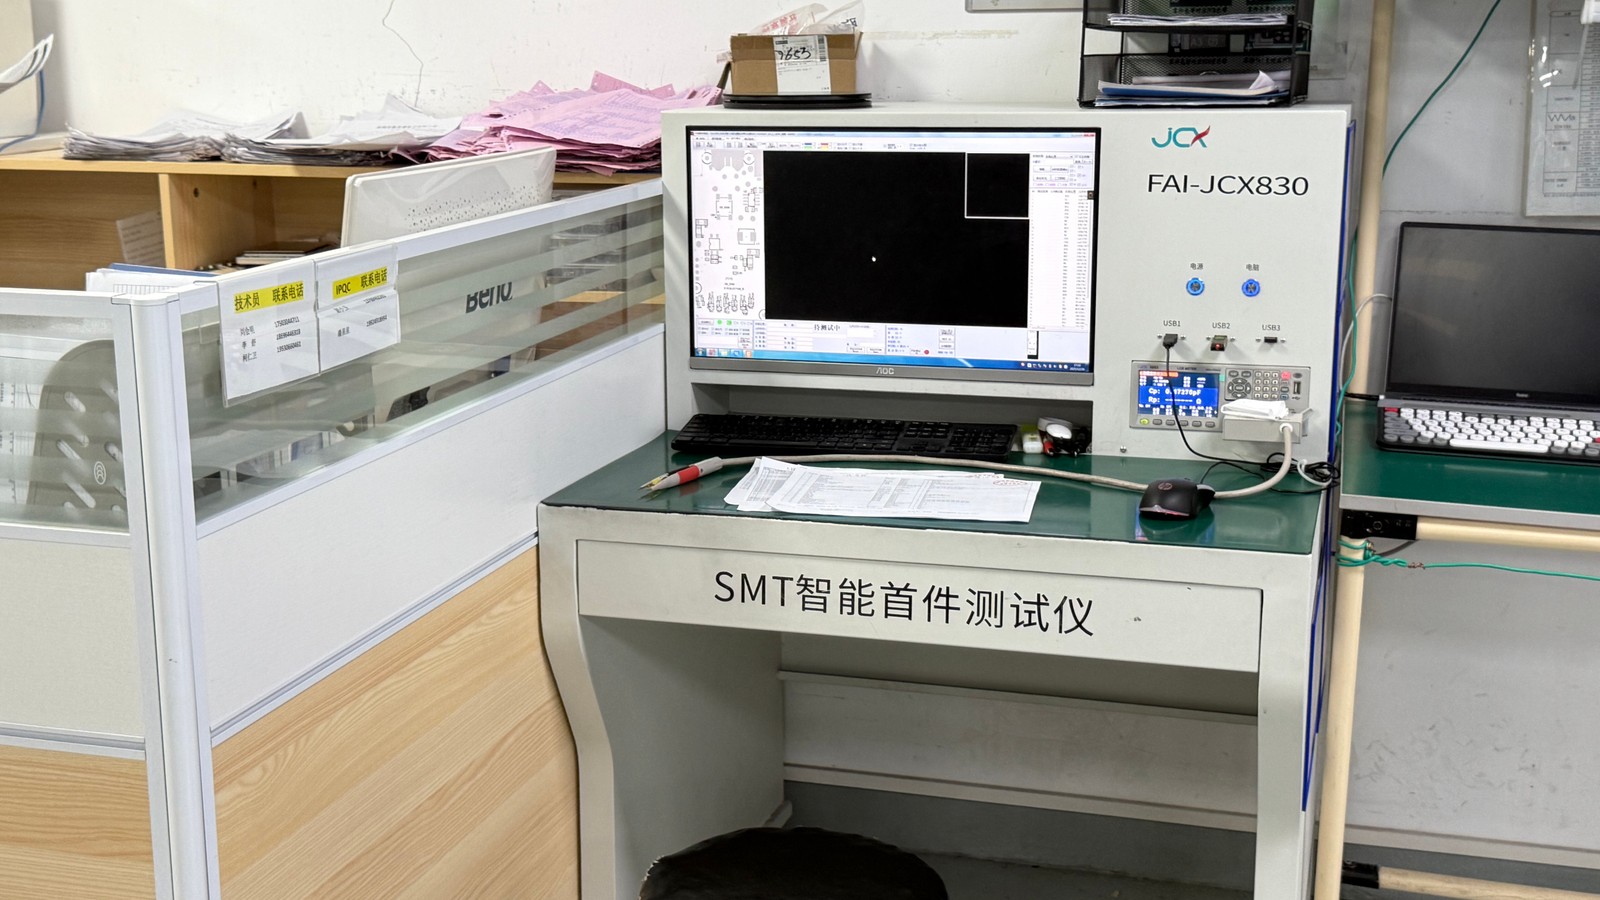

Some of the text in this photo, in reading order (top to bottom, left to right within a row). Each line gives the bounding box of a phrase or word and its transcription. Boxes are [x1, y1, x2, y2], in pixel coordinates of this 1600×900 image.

[1148, 174, 1309, 196] FAI-JCX830
[1190, 262, 1204, 271] 电源
[1246, 263, 1260, 272] 电脑
[335, 268, 388, 295] IPQC 联系电话
[234, 283, 304, 312] 技术员 联系电话
[876, 367, 895, 375] AOC
[1148, 396, 1160, 404] Rp:
[714, 571, 1094, 637] SMT智能首件测试仪
